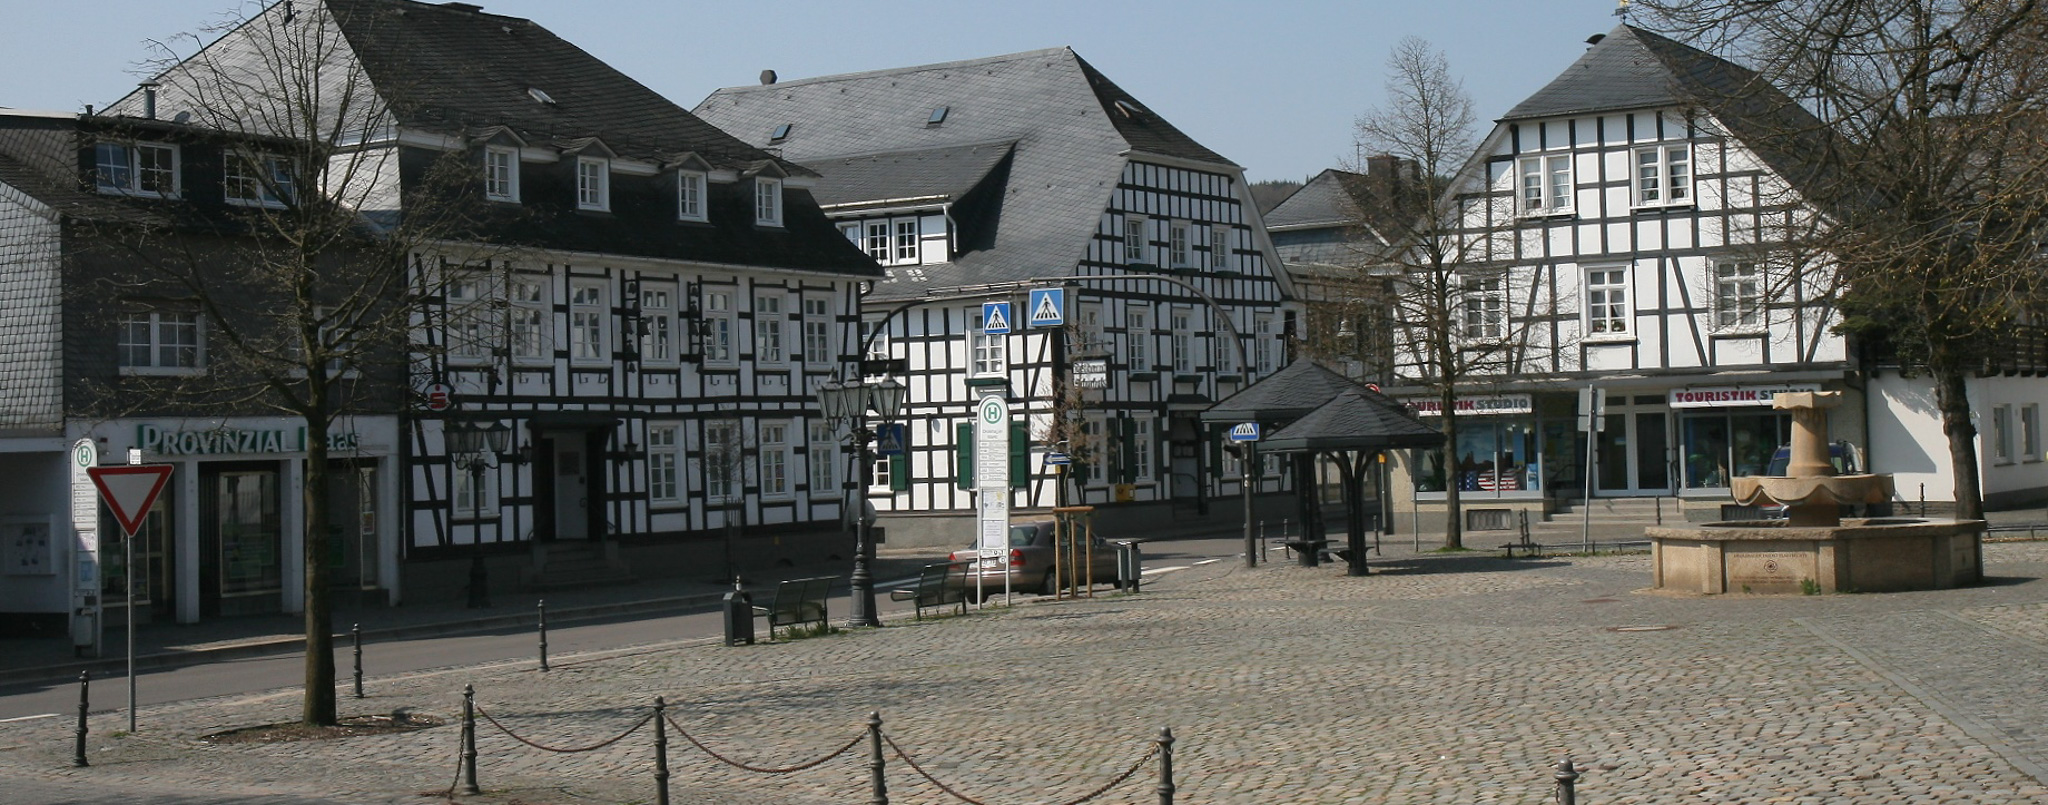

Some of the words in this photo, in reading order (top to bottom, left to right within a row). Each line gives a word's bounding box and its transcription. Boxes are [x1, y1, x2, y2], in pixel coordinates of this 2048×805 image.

[1675, 391, 1757, 402] TOURISTIK
[1476, 398, 1528, 410] STUDIO
[303, 427, 361, 451] aas
